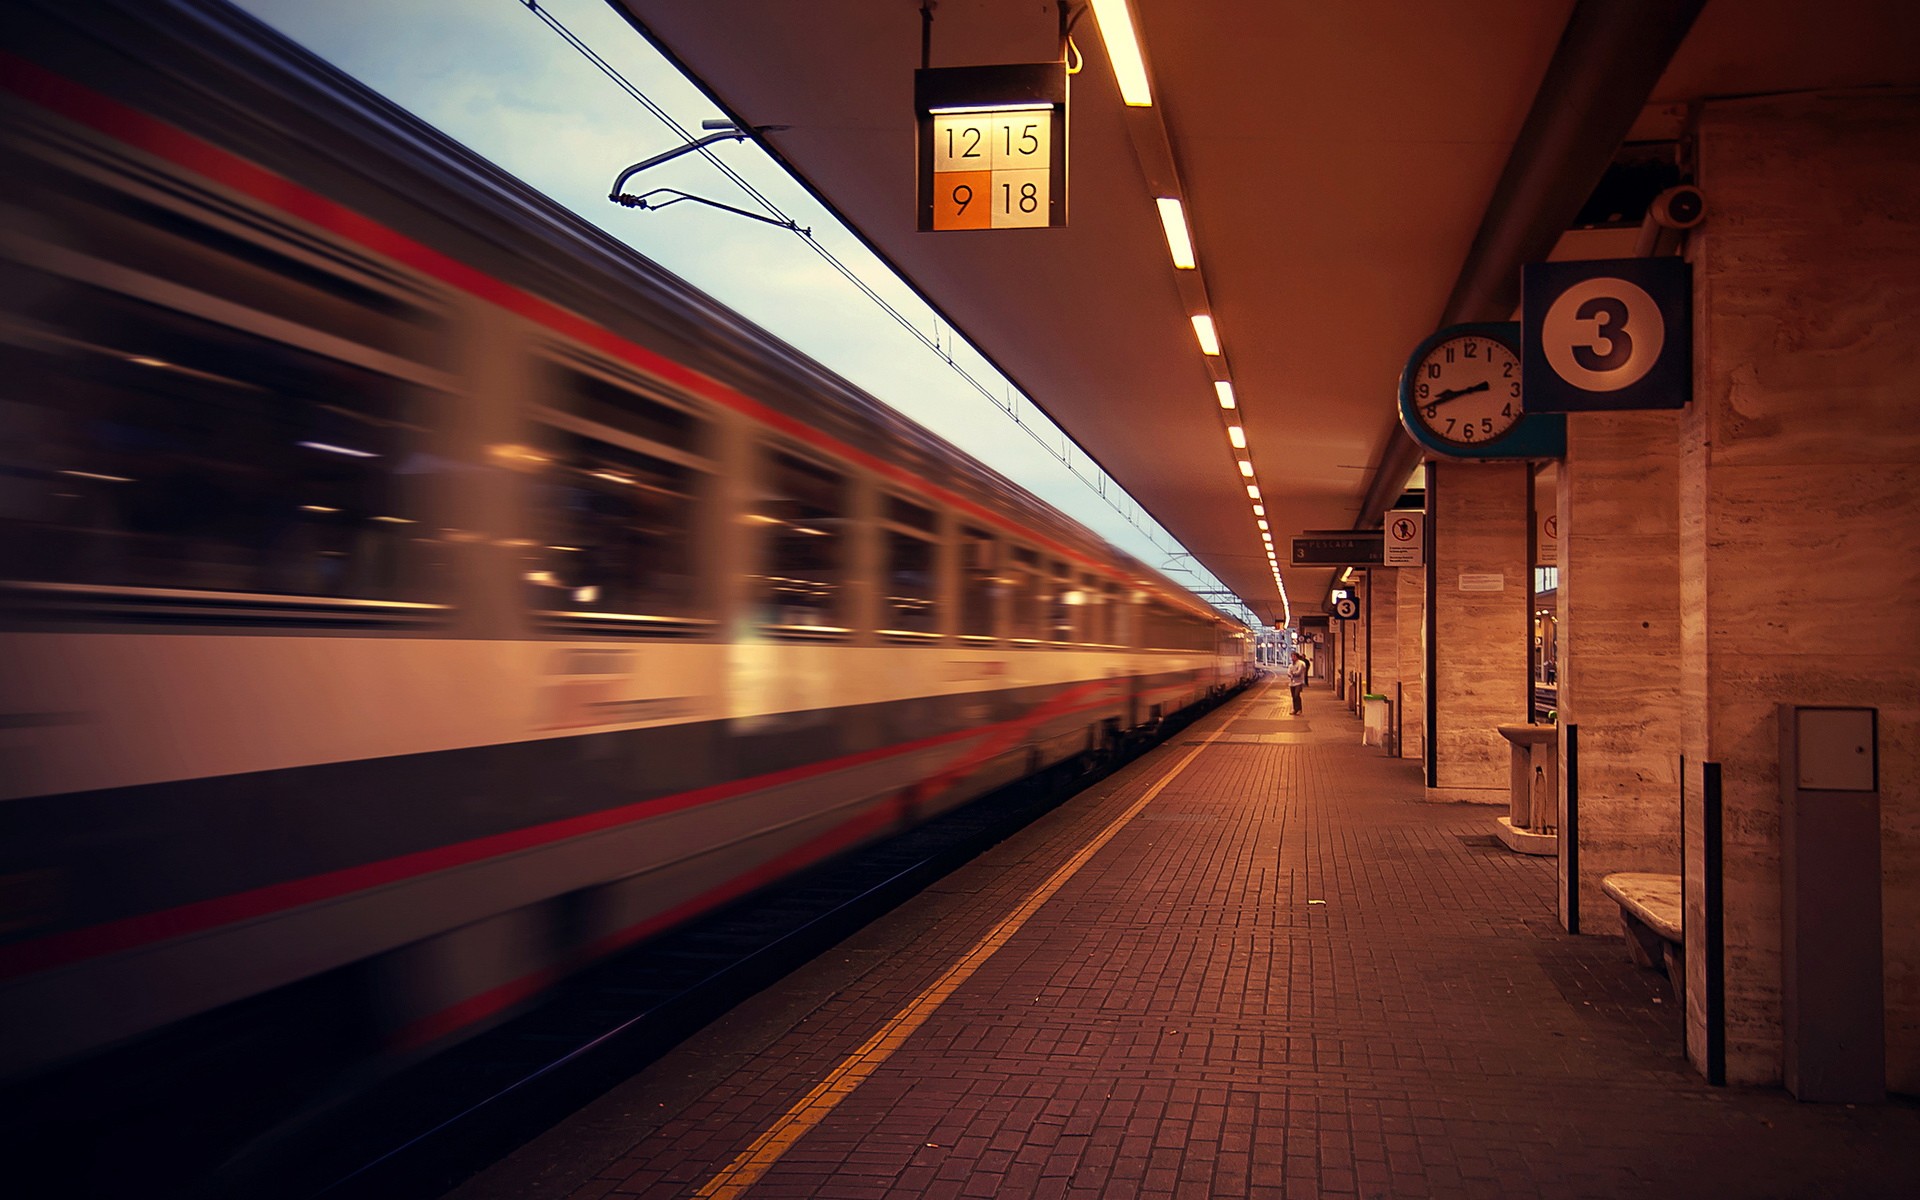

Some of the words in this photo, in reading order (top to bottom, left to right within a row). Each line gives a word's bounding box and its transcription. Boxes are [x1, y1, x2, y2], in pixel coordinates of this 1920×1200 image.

[946, 127, 981, 158] 12
[1003, 124, 1038, 155] 15
[952, 185, 973, 216] 9
[1002, 183, 1038, 214] 18
[1571, 296, 1633, 373] 3
[1446, 347, 1455, 363] 11
[1463, 342, 1477, 358] 12
[1487, 347, 1492, 362] 1
[1428, 363, 1441, 379] 10
[1502, 362, 1513, 378] 2
[1419, 383, 1430, 399] 9
[1510, 382, 1521, 398] 3
[1426, 404, 1437, 419] 8
[1501, 402, 1512, 418] 4
[1445, 418, 1456, 434] 7
[1463, 424, 1474, 439] 6
[1481, 418, 1493, 433] 5
[1296, 548, 1305, 559] 3
[1341, 602, 1352, 617] 3
